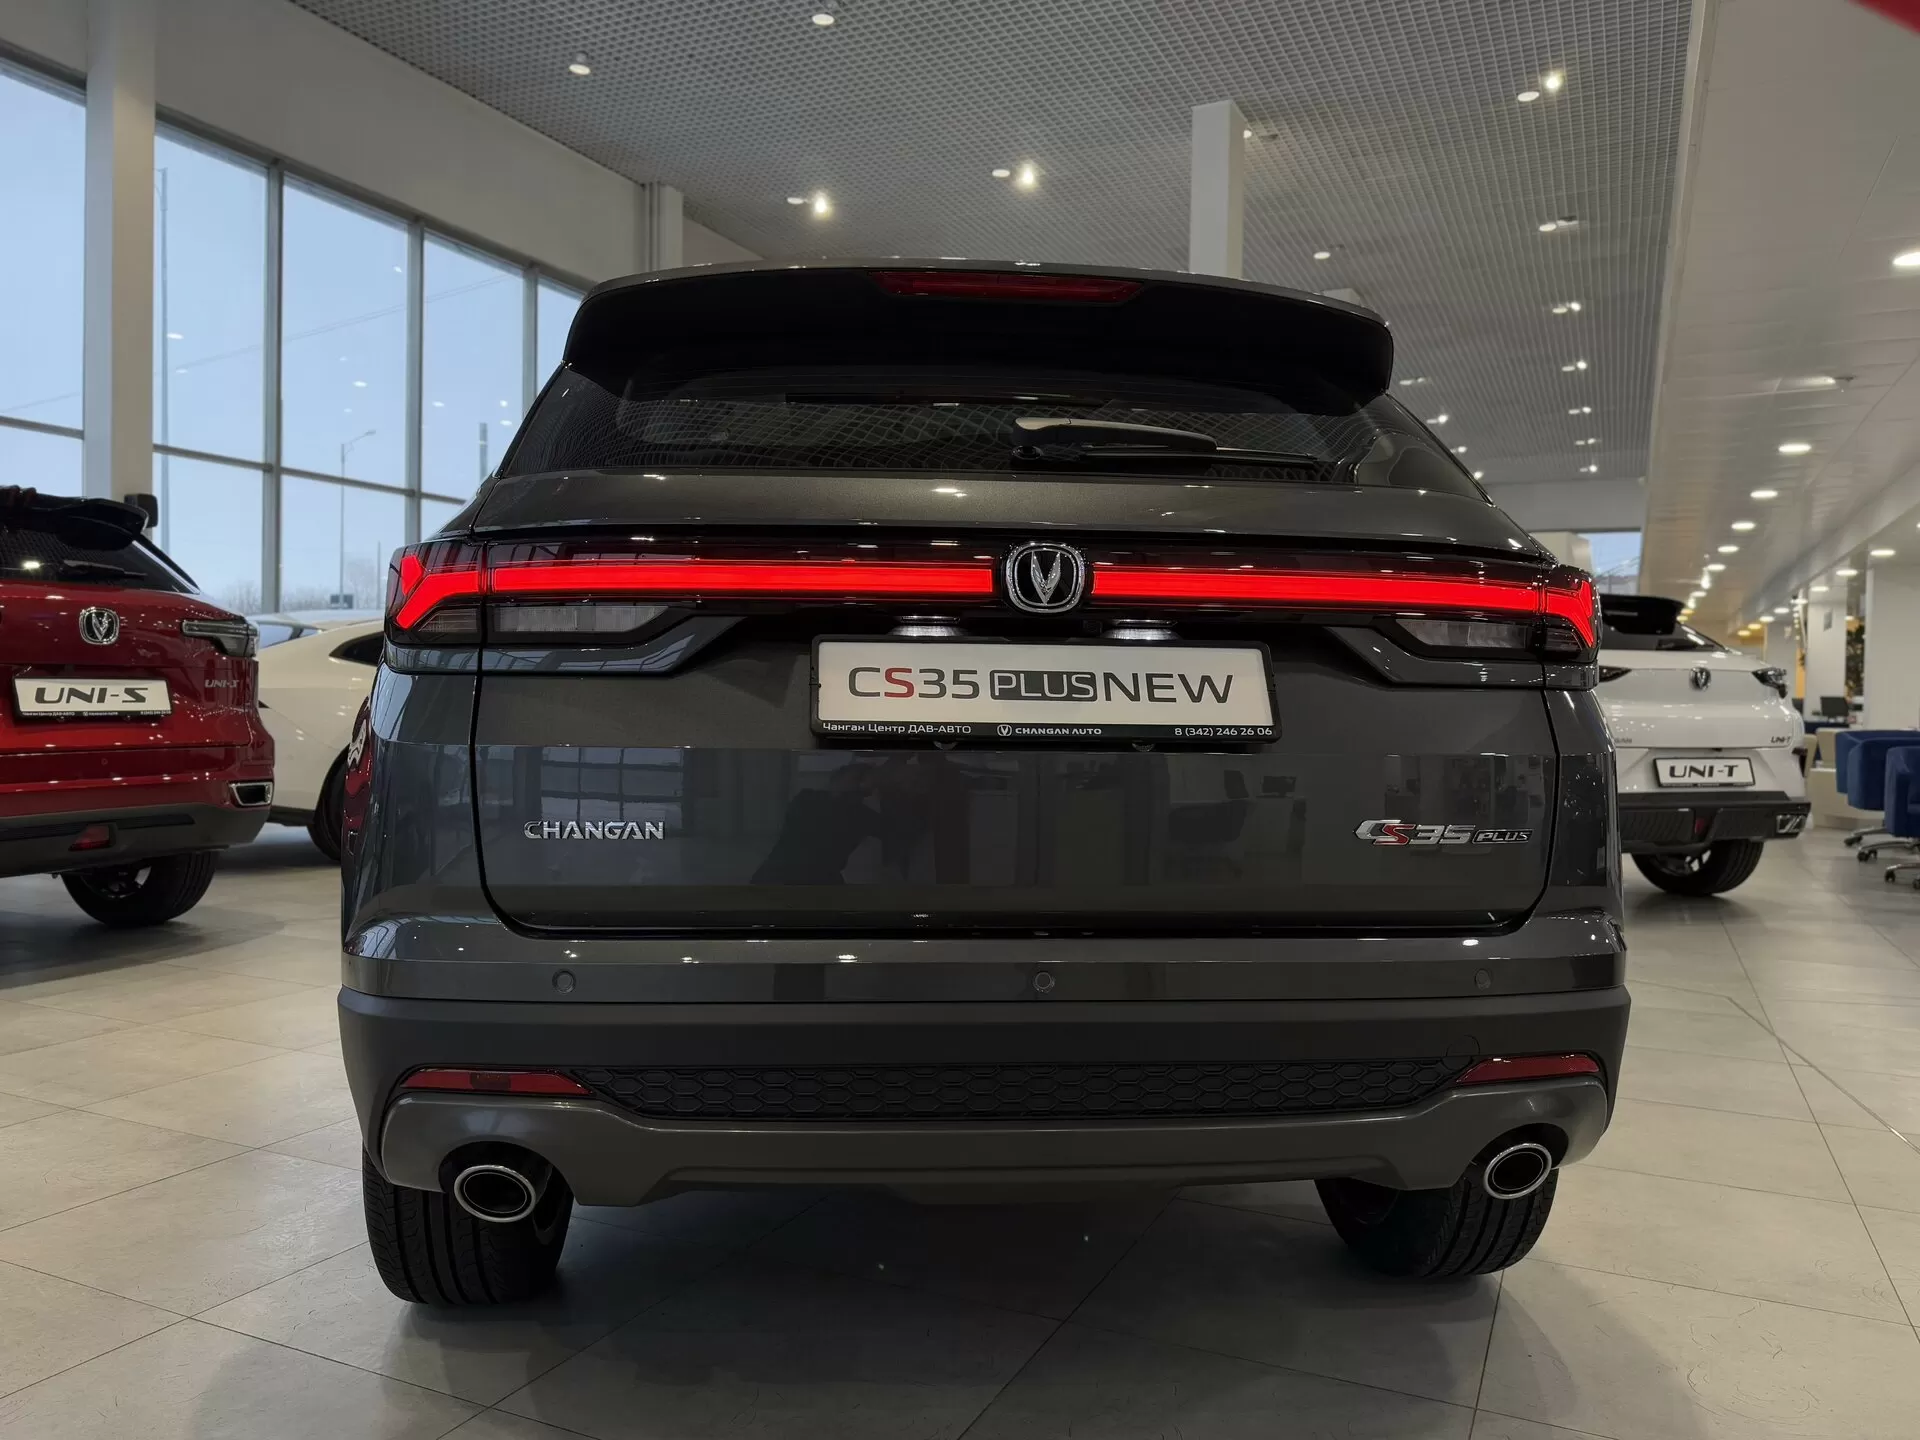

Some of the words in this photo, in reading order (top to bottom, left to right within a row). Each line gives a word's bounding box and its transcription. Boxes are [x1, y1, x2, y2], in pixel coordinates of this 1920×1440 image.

[848, 667, 980, 699] CS35
[993, 671, 1095, 700] PLUS
[1103, 672, 1234, 704] NEW
[35, 687, 148, 704] UNI-S
[822, 722, 865, 731] Чанган
[868, 723, 905, 733] Центр
[908, 724, 972, 733] ДАВ-АВТО
[1015, 727, 1070, 735] CHANGAN
[1174, 727, 1183, 736] 8
[1185, 727, 1214, 737] (342)
[1216, 727, 1238, 736] 246
[1240, 727, 1255, 736] 26
[1257, 727, 1273, 736] 06
[1669, 765, 1739, 778] UNI-T
[523, 820, 664, 840] CHANGAN
[1355, 819, 1476, 846] CS35
[1475, 830, 1533, 843] PLUS
